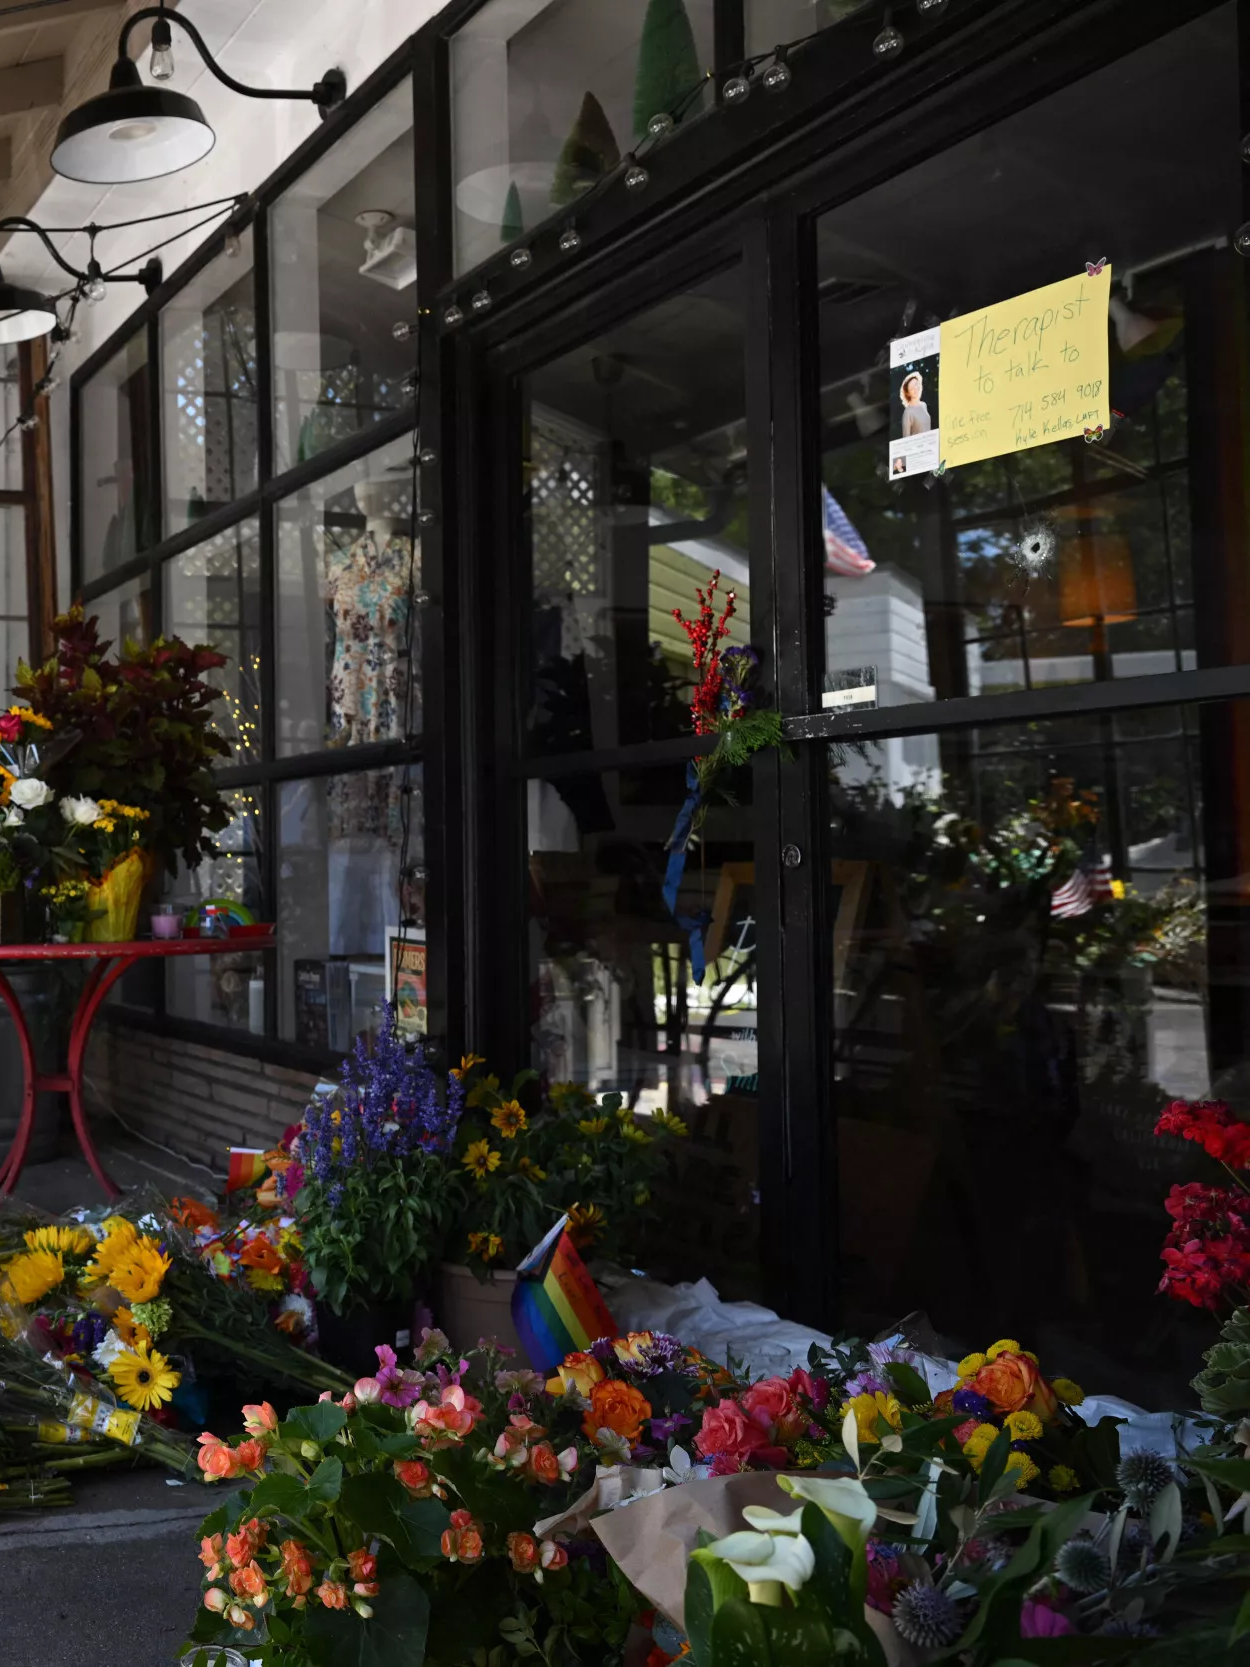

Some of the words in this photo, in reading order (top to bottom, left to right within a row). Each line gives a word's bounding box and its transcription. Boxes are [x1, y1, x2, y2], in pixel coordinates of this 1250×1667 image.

[953, 282, 1091, 369] Therapist
[973, 364, 995, 395] to
[1004, 350, 1050, 383] talk
[1059, 339, 1080, 363] to
[1008, 400, 1033, 428] 714
[1040, 388, 1066, 411] 584
[1076, 379, 1103, 400] 9018
